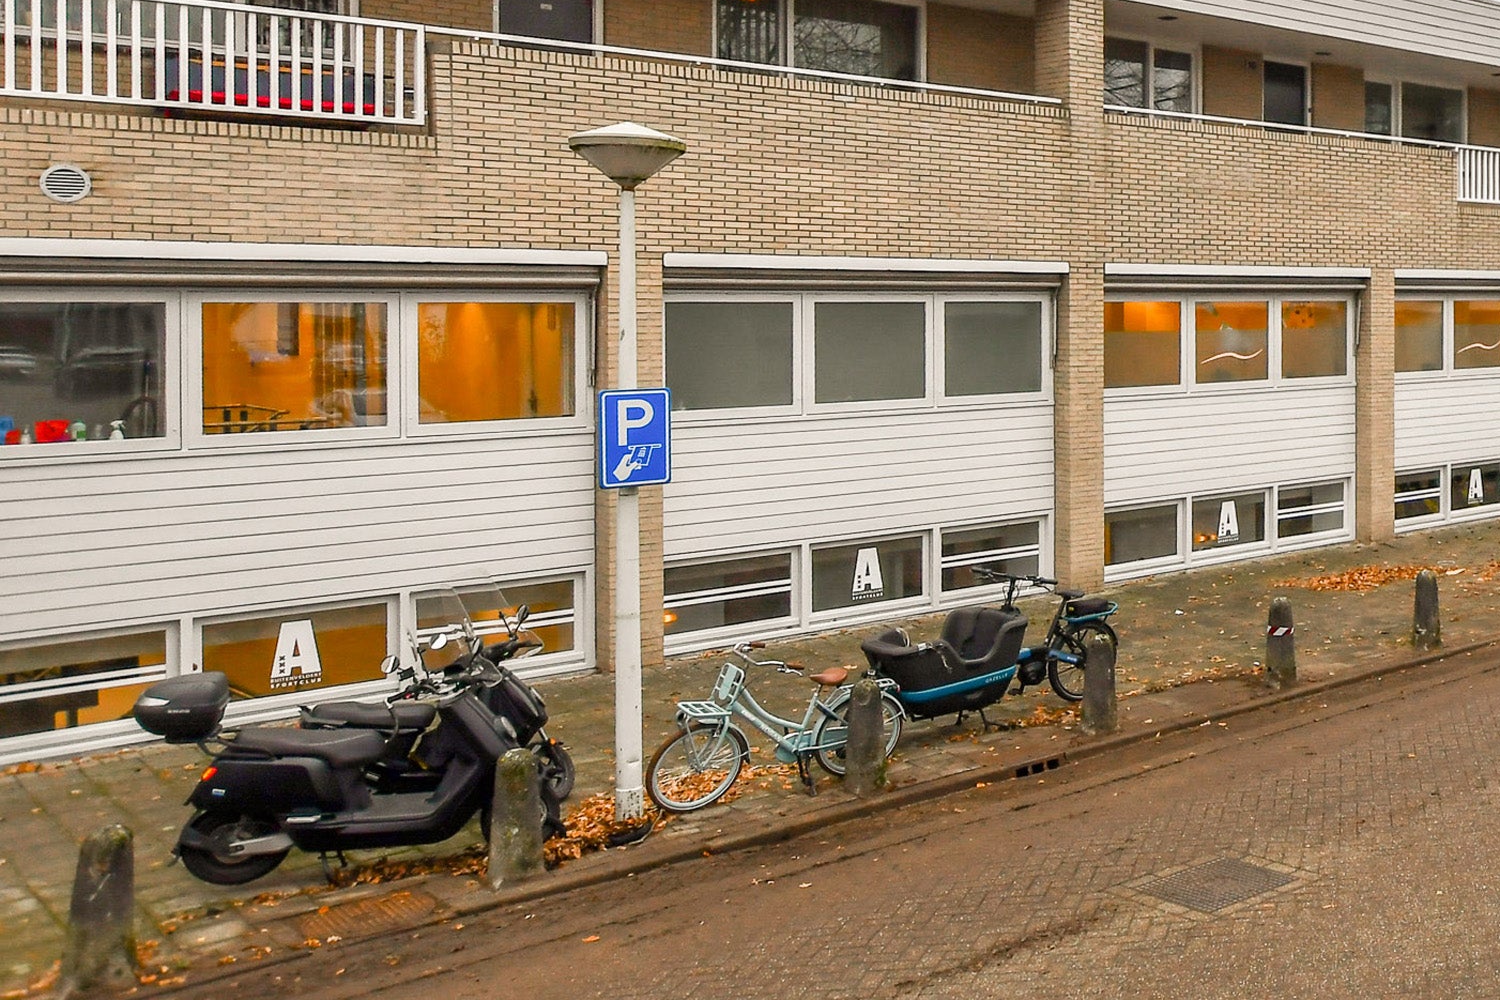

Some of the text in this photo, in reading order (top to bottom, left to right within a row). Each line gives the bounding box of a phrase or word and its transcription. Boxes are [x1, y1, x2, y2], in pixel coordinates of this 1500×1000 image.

[617, 399, 654, 446] P
[1468, 468, 1484, 499] A
[1217, 500, 1239, 538] A
[852, 547, 884, 592] A
[270, 619, 322, 679] A
